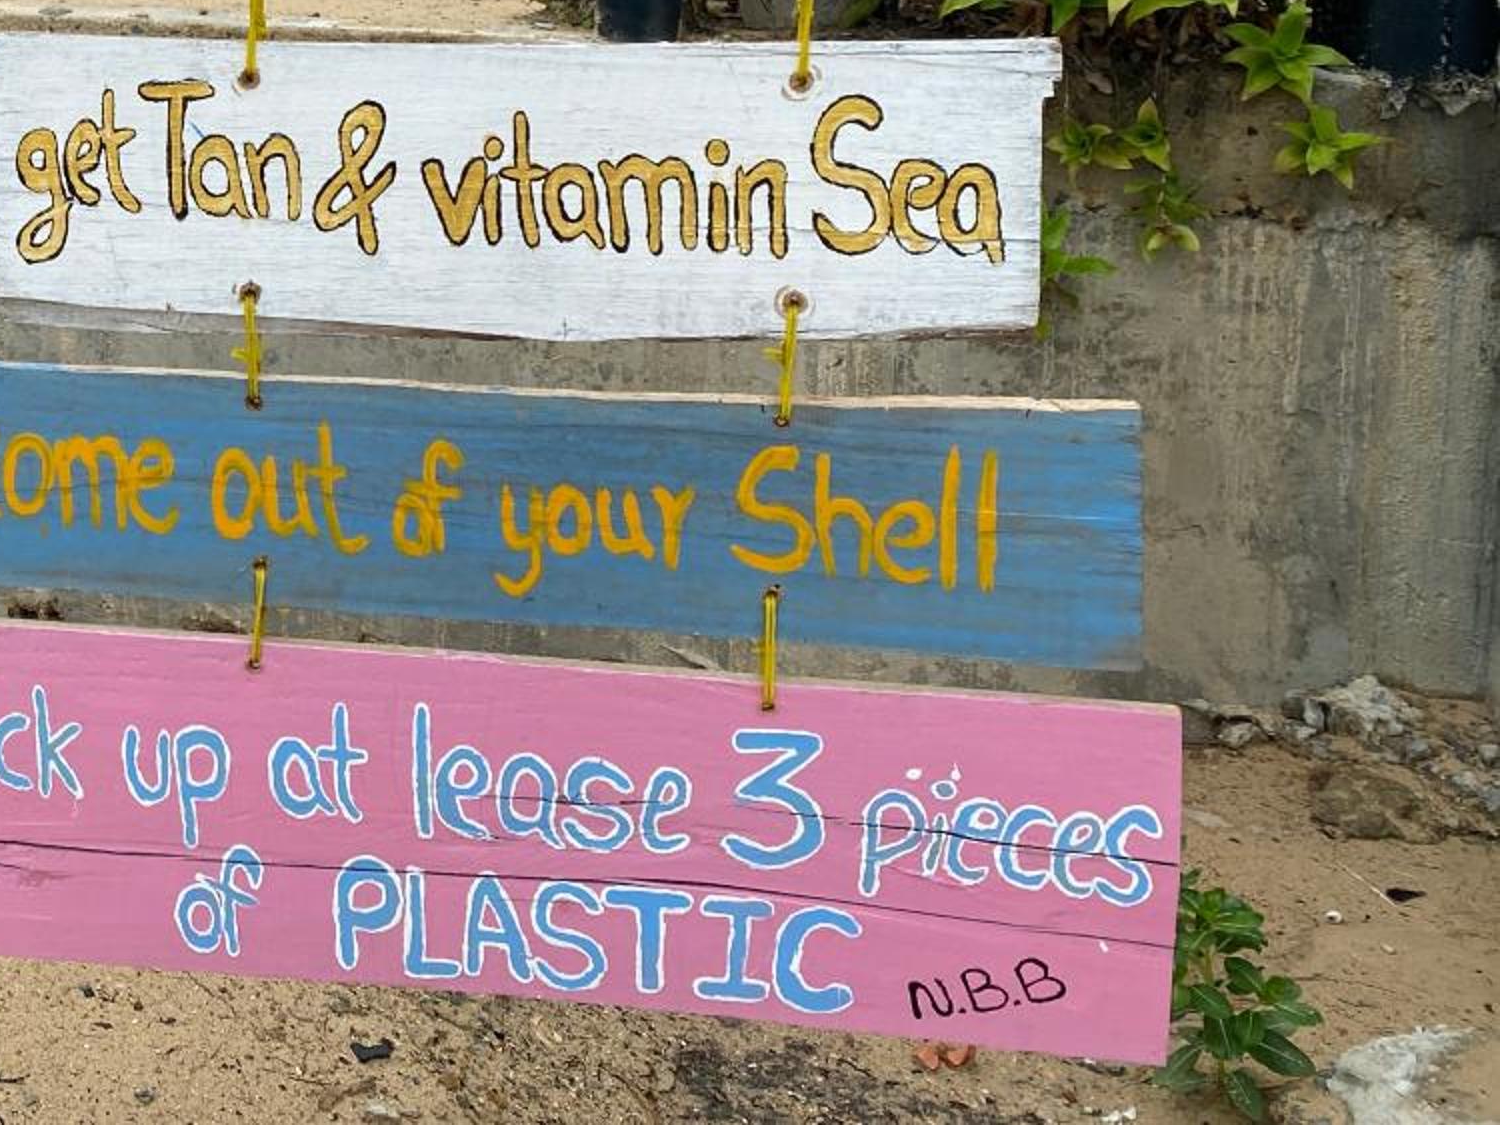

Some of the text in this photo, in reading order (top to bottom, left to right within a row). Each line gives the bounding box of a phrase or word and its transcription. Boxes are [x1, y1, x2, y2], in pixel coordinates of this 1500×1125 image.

[15, 77, 1006, 267] get Tan & vitamin Sea
[210, 419, 368, 556] out
[392, 440, 465, 559] of
[494, 483, 695, 598] your
[731, 444, 999, 592] Shell
[120, 722, 231, 849] up
[269, 701, 368, 822] at
[411, 701, 691, 852] lease
[723, 727, 825, 871] 3
[857, 760, 1163, 906] pieces
[176, 844, 867, 1014] of PLASTIC
